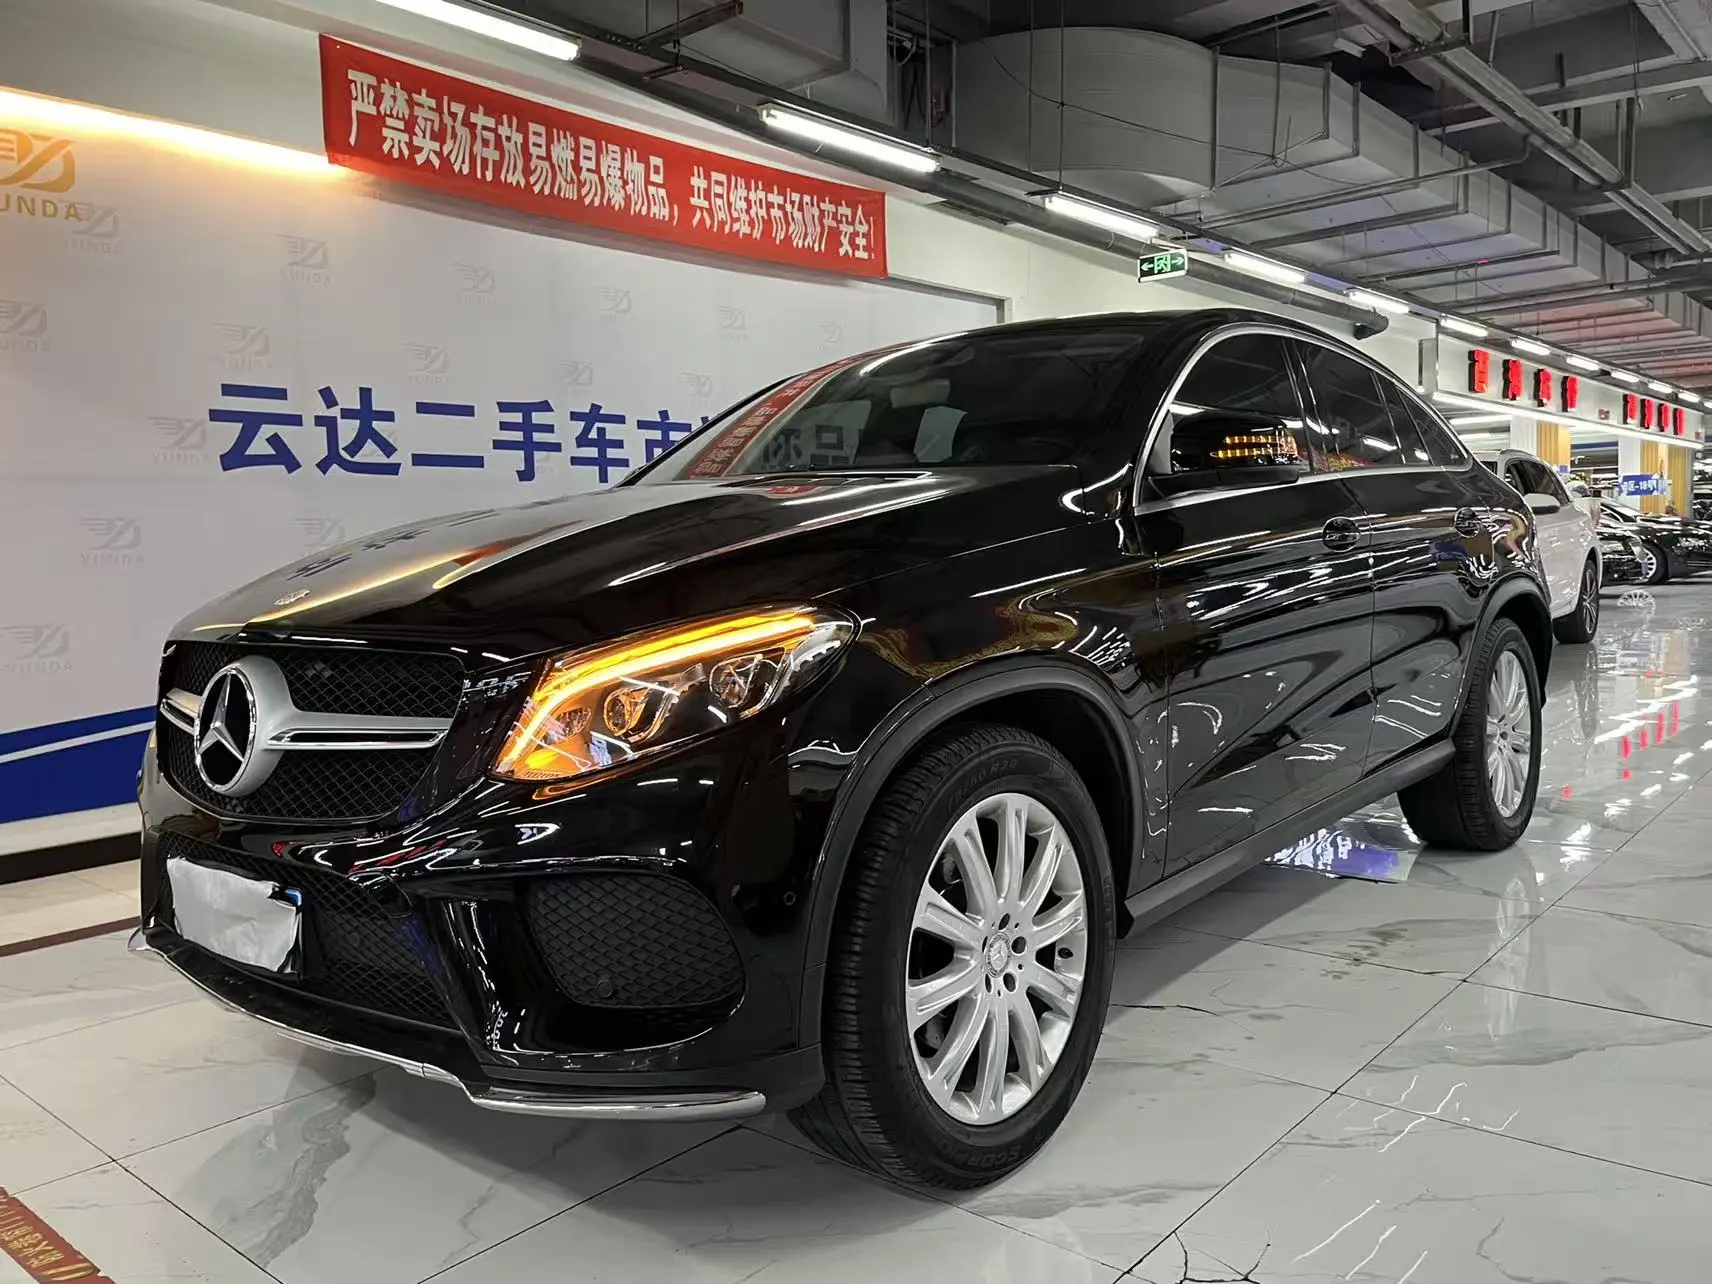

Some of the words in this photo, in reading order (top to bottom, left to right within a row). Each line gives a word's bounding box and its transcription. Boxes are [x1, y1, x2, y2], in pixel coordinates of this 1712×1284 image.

[208, 382, 710, 485] 云达二手车市
